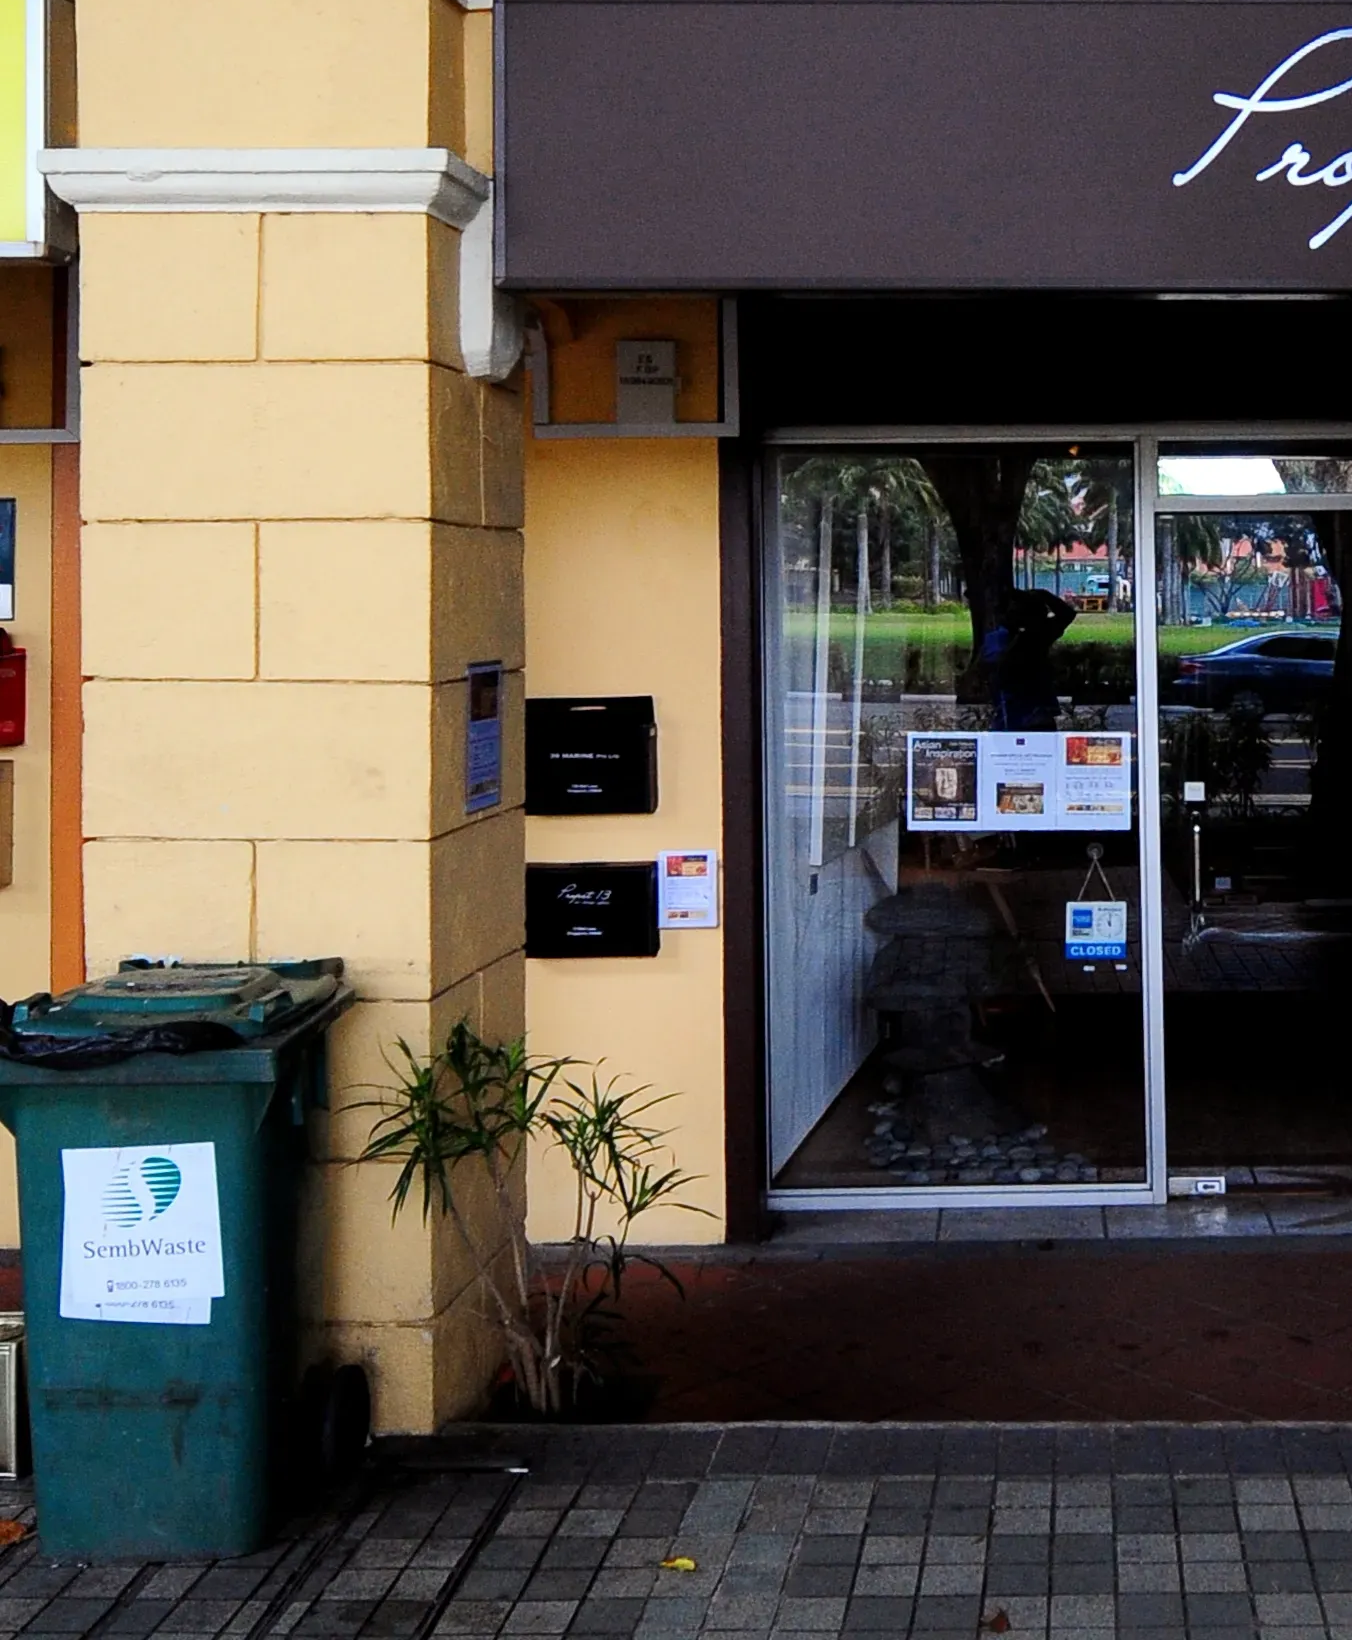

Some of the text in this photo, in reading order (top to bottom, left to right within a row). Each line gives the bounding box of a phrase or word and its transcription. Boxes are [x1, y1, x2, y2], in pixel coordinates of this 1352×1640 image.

[914, 740, 942, 752] Asian
[925, 749, 977, 759] Inspiration
[595, 890, 612, 901] 13
[1070, 945, 1121, 956] CLOSED
[83, 1238, 206, 1258] SembWaste
